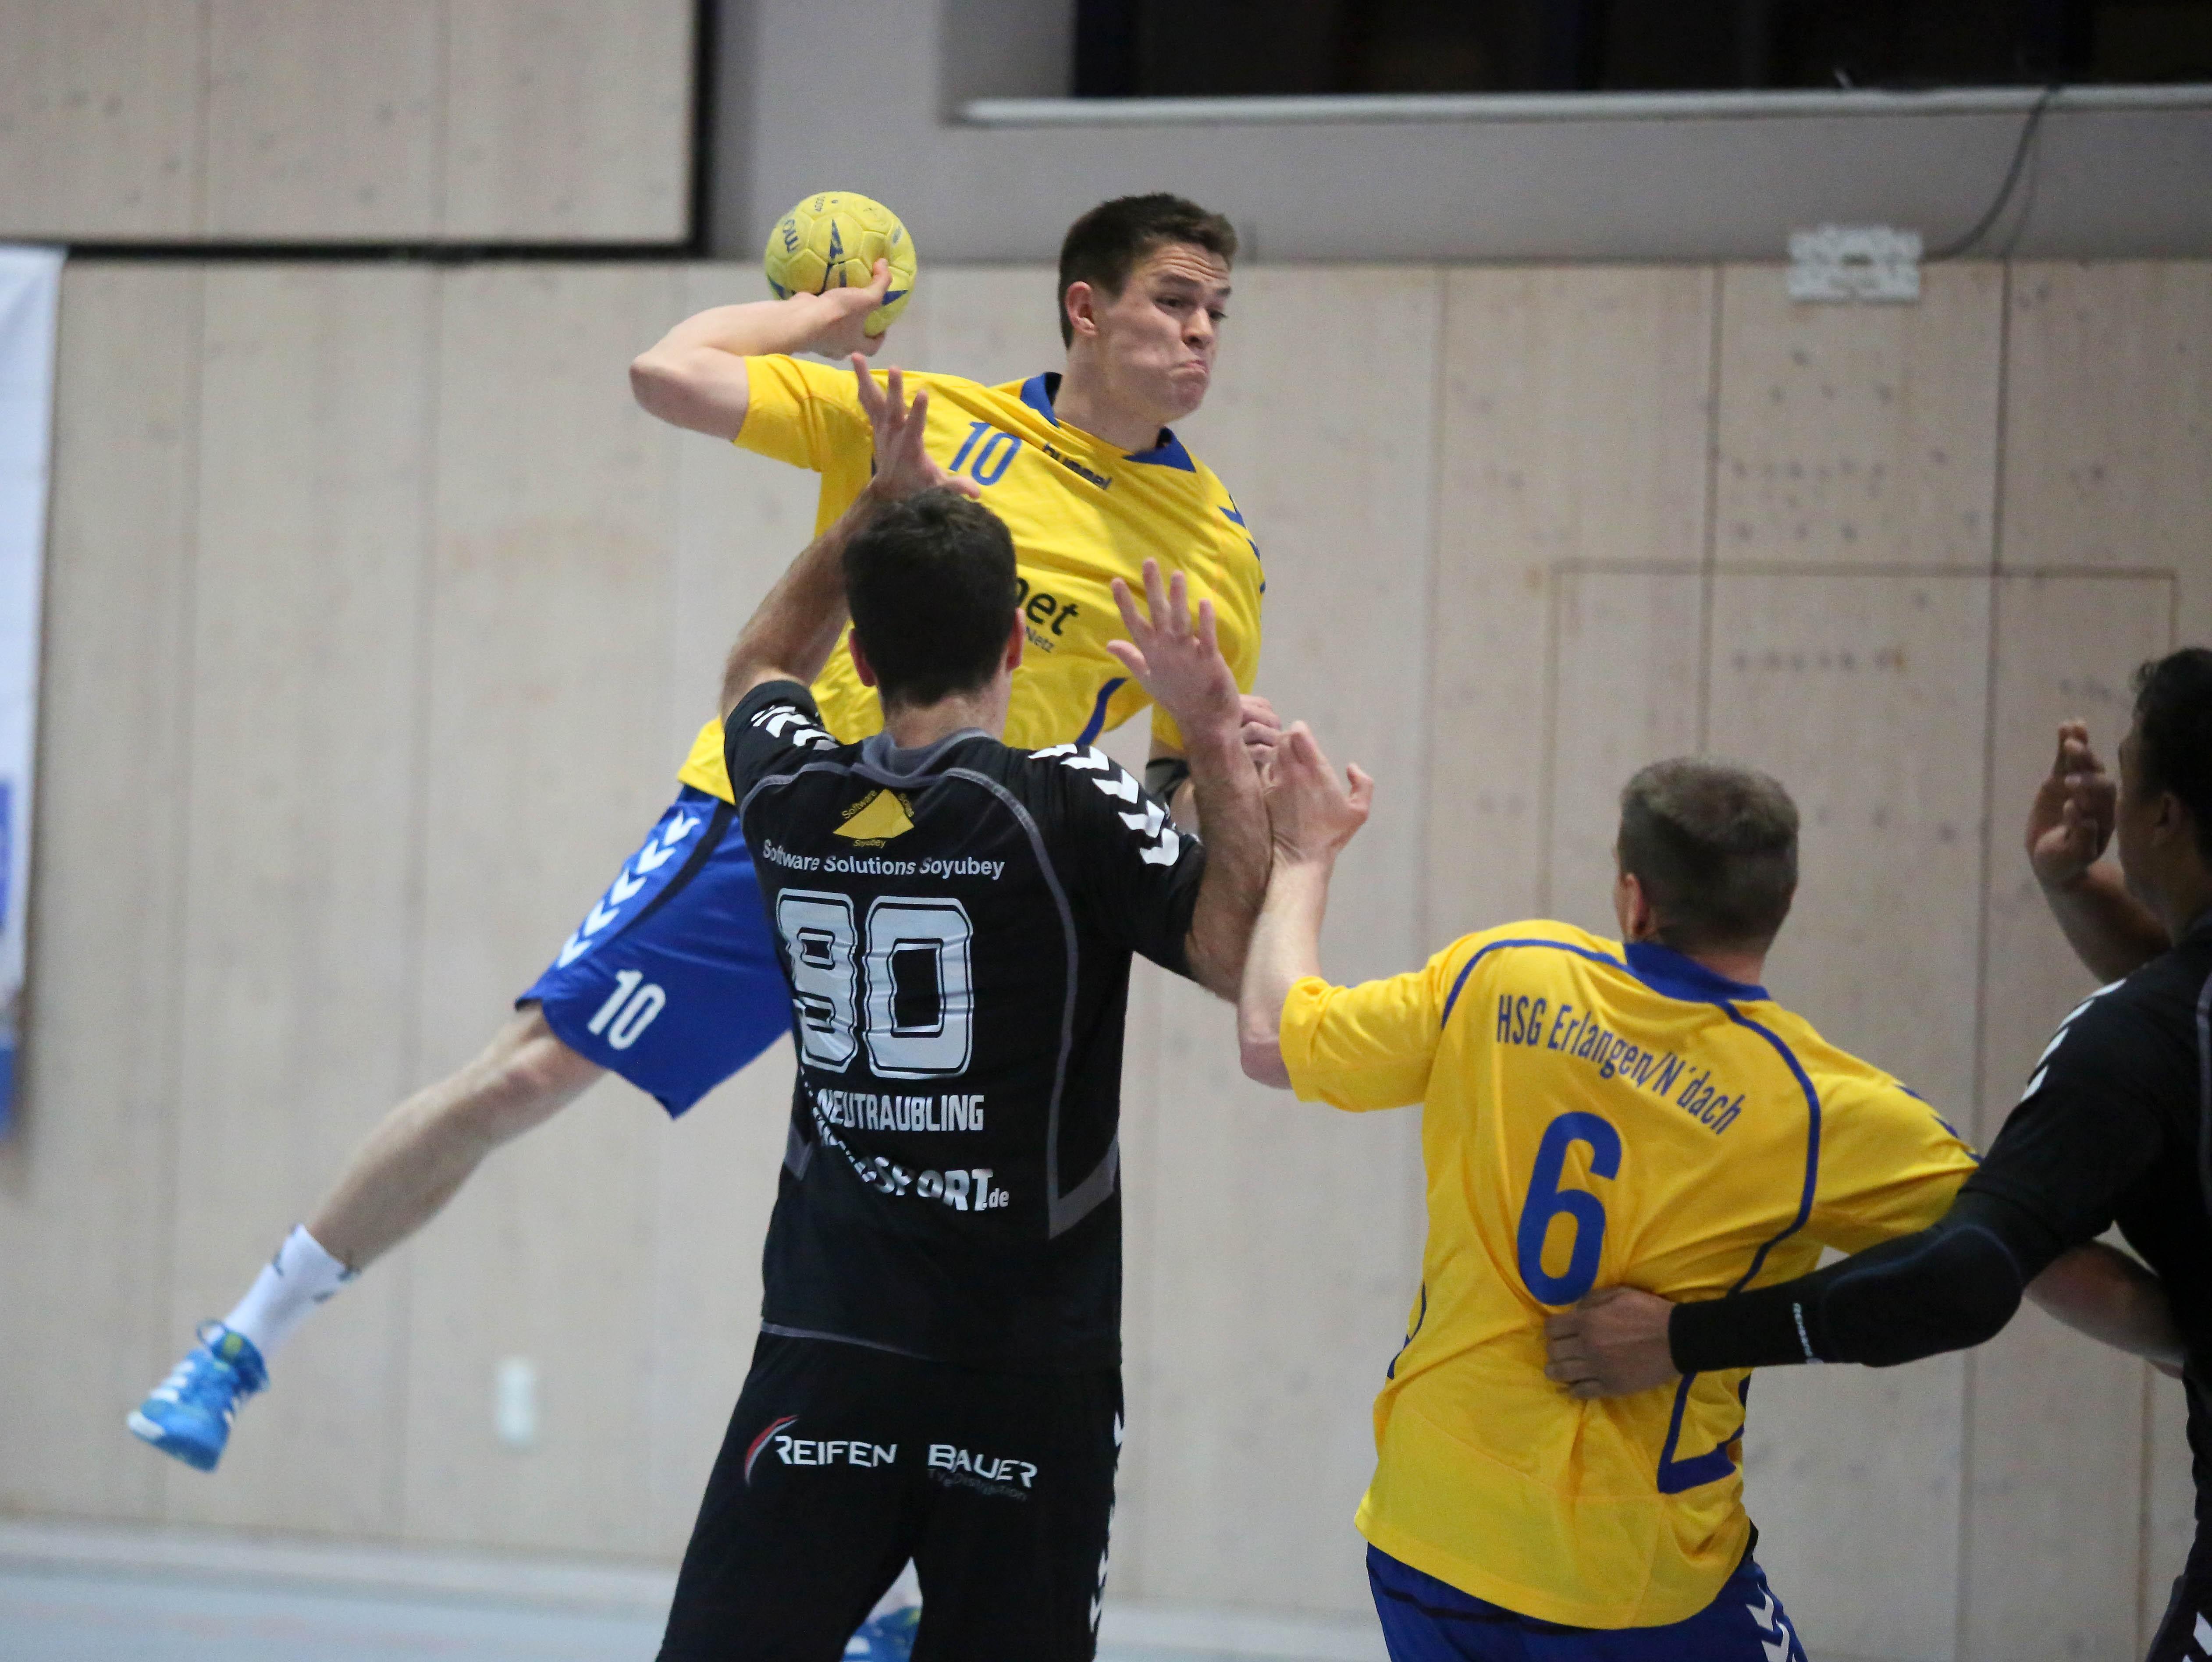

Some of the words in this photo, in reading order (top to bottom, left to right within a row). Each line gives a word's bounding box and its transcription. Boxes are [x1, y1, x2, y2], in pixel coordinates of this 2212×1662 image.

[949, 421, 1022, 486] 10
[763, 839, 820, 871] Software
[823, 856, 917, 876] Solutions
[919, 857, 1005, 881] Soyubey
[587, 969, 666, 1051] 10
[1497, 993, 1547, 1047] HSG
[817, 1088, 985, 1132] NEUTRAUBLING
[1517, 1111, 1622, 1306] 6
[775, 1435, 897, 1467] REIFEN
[928, 1444, 1038, 1488] BAUER
